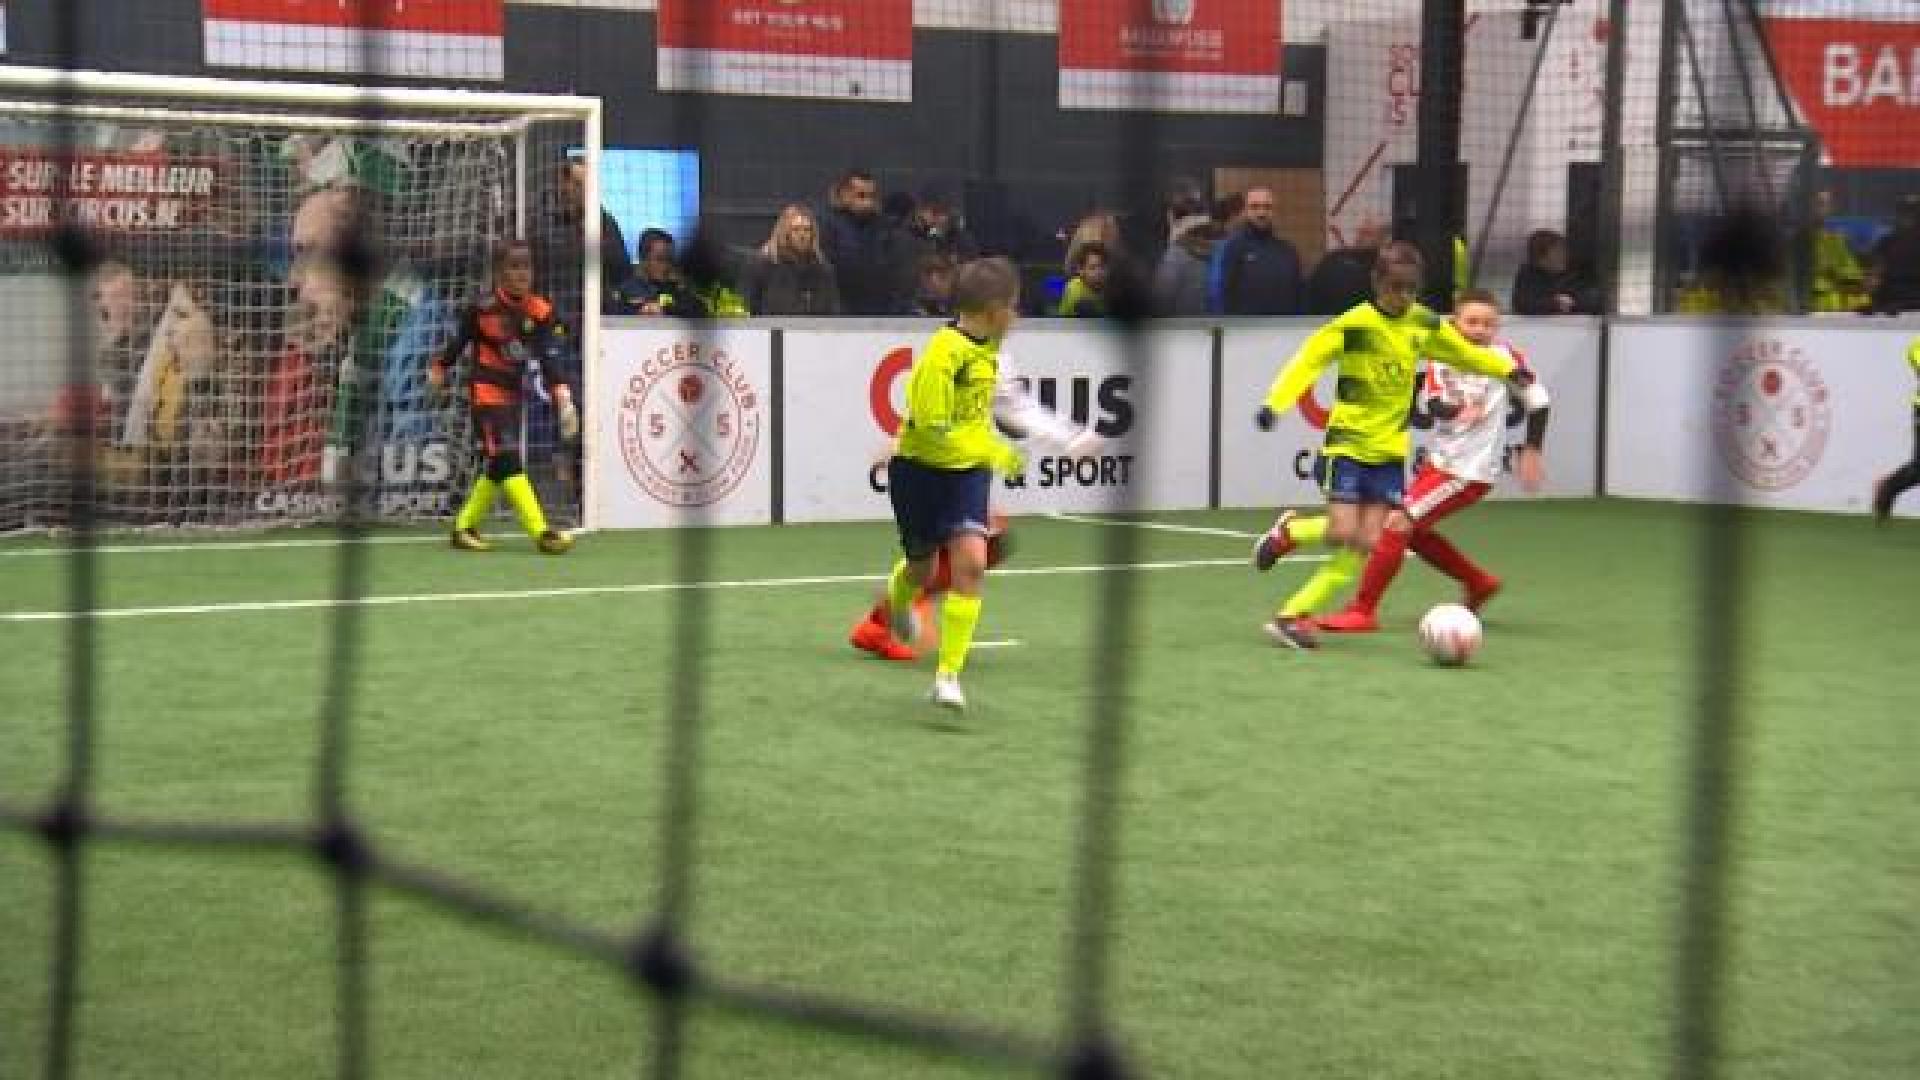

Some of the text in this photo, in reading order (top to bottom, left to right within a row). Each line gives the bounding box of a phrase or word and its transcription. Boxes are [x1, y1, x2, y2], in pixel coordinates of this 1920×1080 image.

[8, 161, 214, 195] SUR LE MEILLEUR
[1, 197, 50, 228] SUR
[622, 342, 757, 411] SOCCER CLUB
[649, 413, 731, 438] 5 5
[1038, 455, 1134, 487] SPORT
